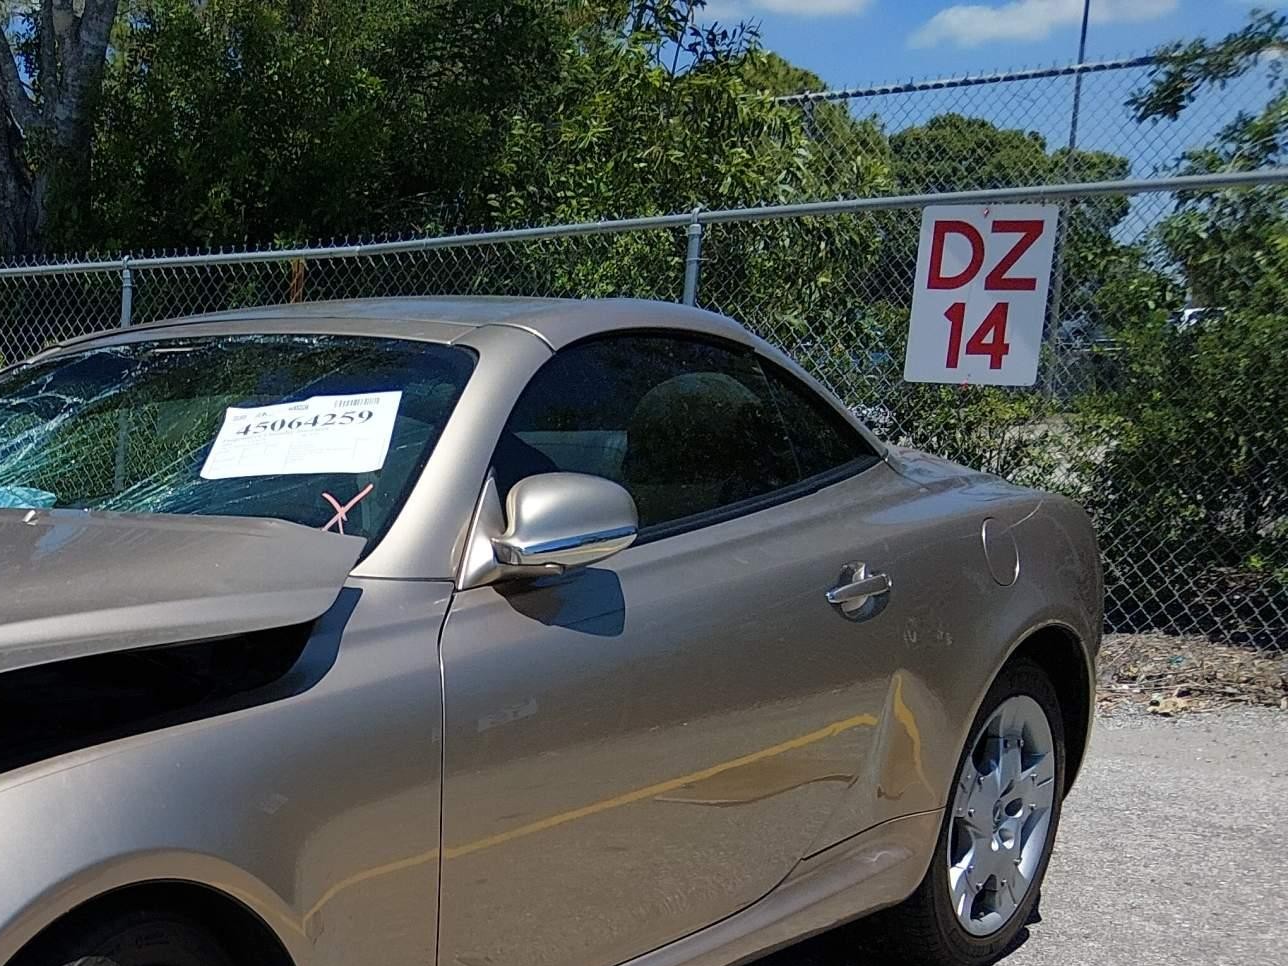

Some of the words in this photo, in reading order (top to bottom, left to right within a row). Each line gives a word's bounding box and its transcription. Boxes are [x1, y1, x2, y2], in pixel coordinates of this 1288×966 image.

[927, 219, 1044, 290] DZ
[943, 302, 1010, 369] 14
[236, 409, 374, 436] 45064259
